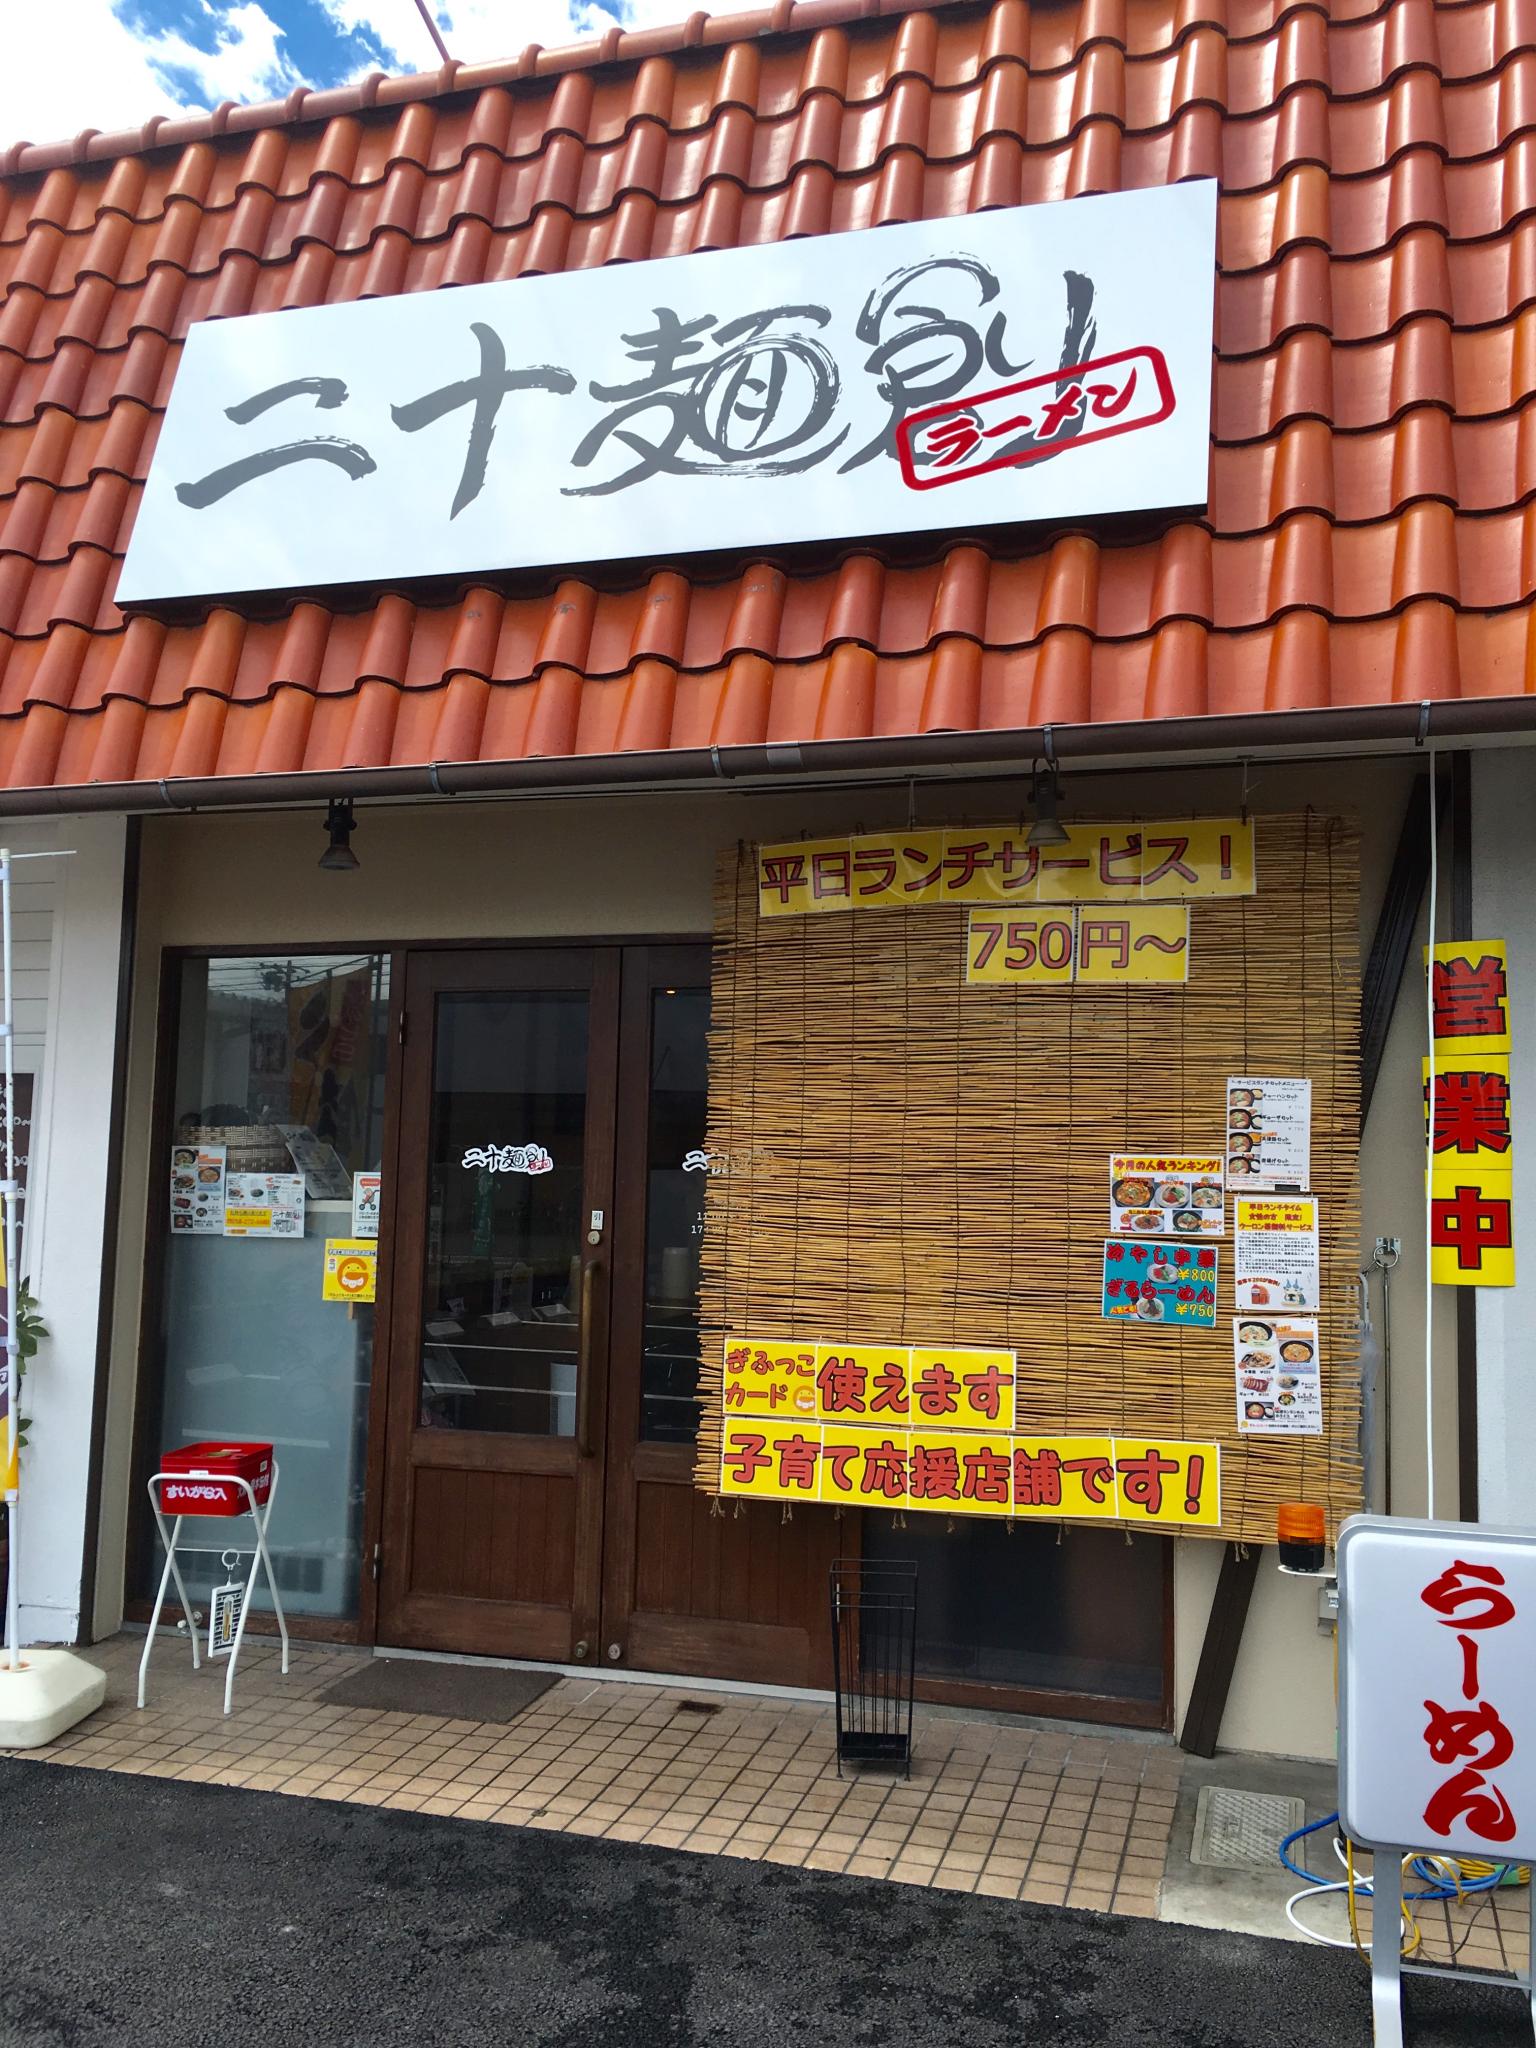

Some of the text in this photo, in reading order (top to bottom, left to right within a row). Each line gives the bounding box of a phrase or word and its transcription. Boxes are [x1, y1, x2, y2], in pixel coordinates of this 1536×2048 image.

[926, 366, 1138, 467] ラーメン
[1425, 955, 1512, 1270] 営業中
[724, 1346, 816, 1378] ぎふっこ
[724, 1379, 788, 1409] カード
[817, 1355, 1014, 1420] 使えます
[166, 1484, 228, 1501] すいがら入
[1420, 1559, 1517, 1842] らーめん
